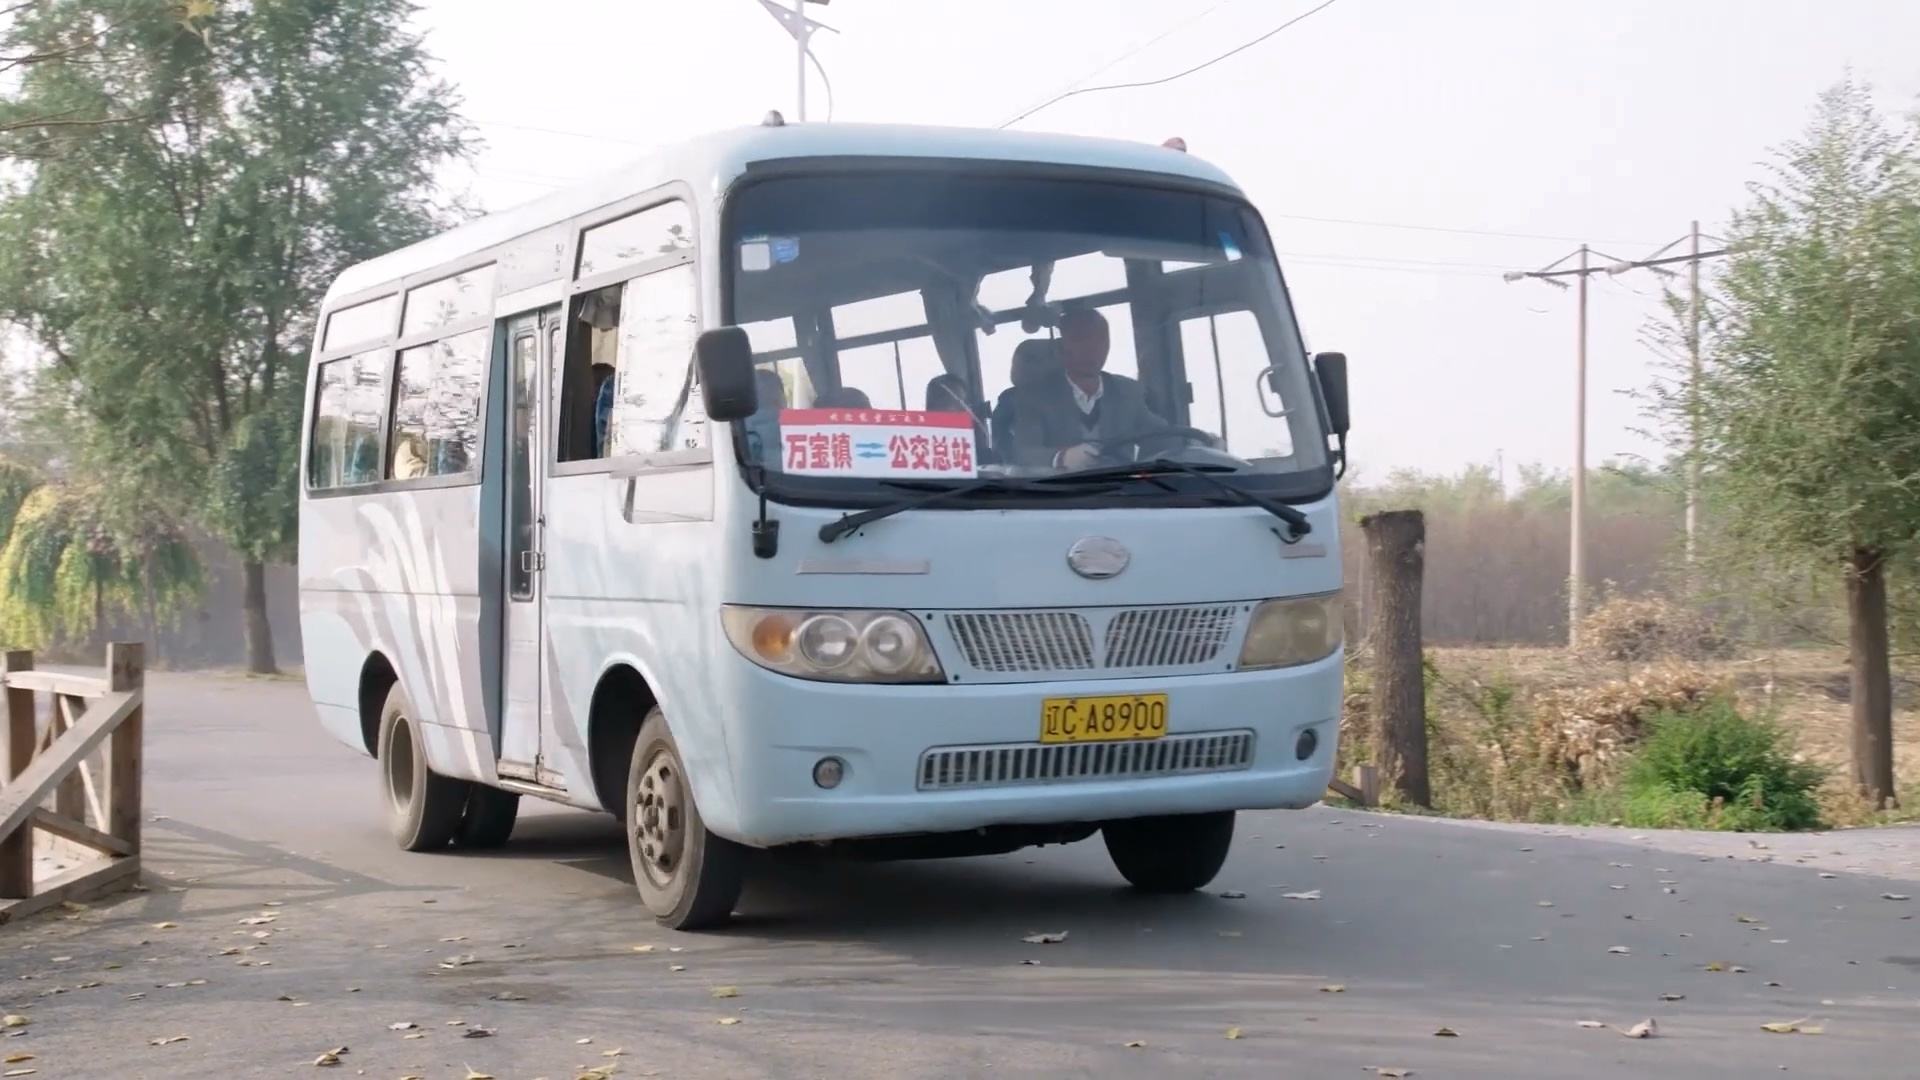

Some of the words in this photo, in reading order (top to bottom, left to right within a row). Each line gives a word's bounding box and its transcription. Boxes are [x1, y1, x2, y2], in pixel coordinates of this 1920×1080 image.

[786, 432, 852, 470] 万宝镇
[888, 434, 972, 472] 公交总站
